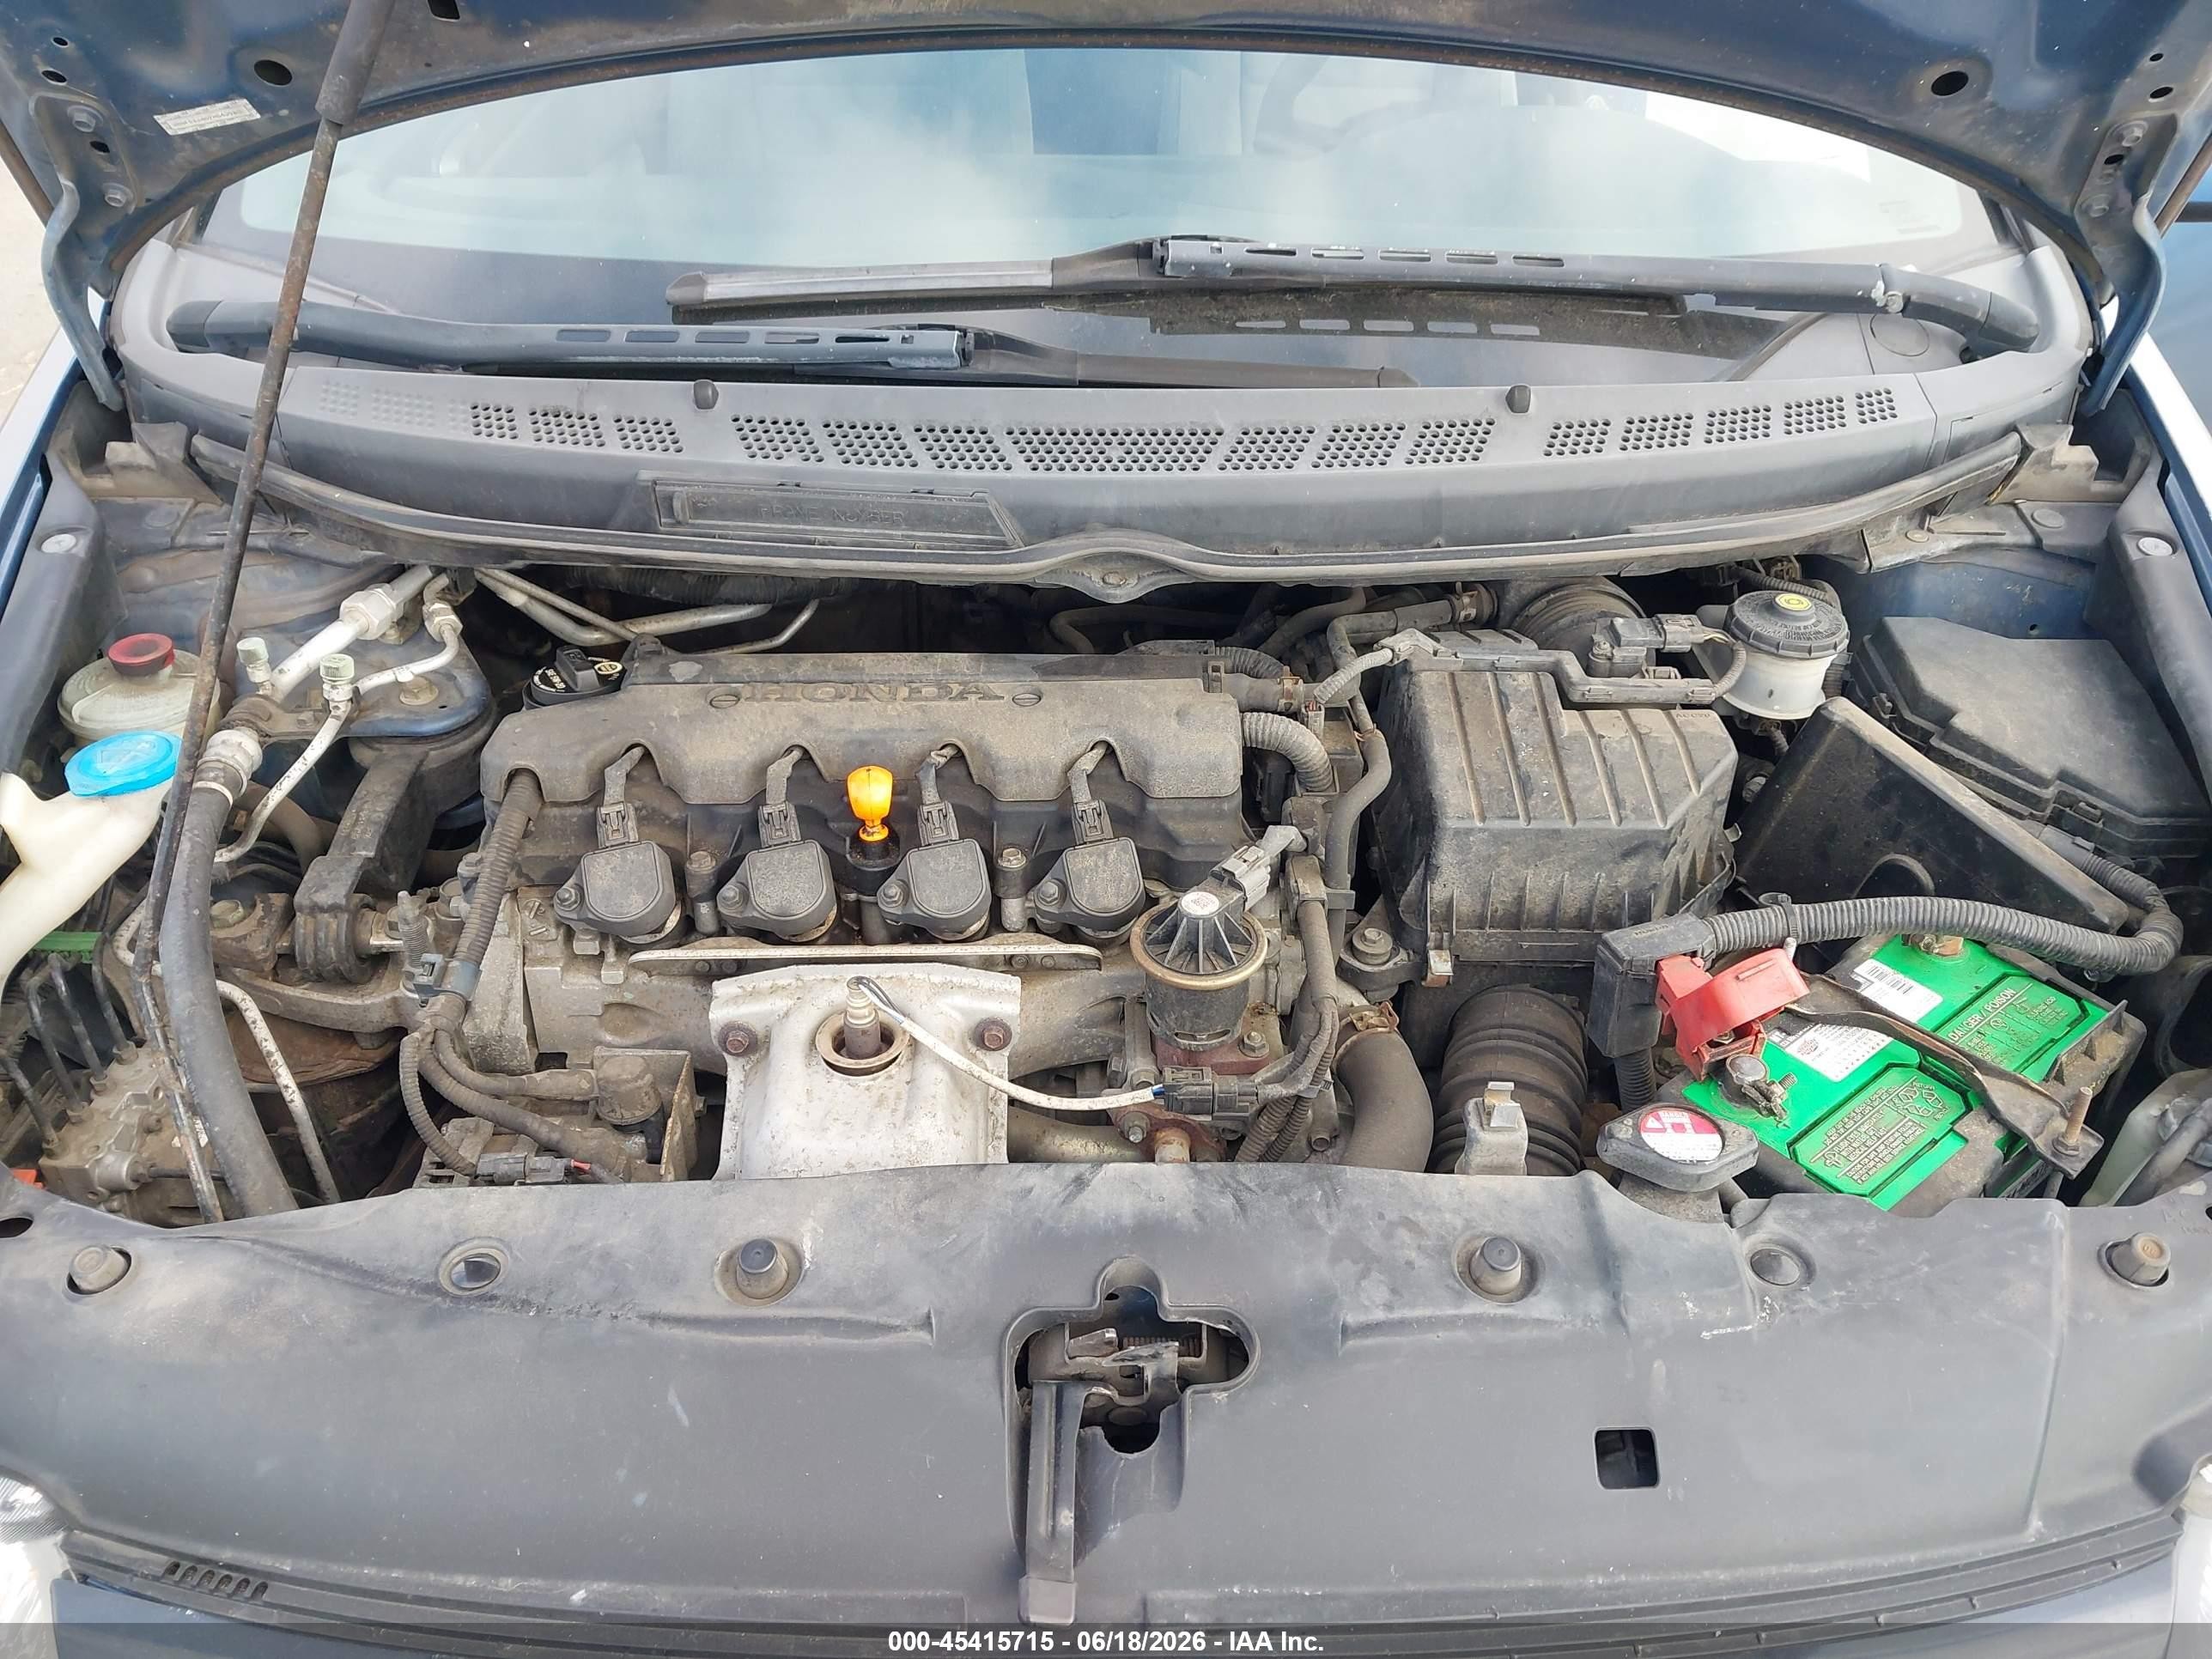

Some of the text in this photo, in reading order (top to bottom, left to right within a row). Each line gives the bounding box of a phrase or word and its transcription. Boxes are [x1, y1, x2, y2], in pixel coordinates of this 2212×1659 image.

[745, 681, 1005, 702] HONDA
[1948, 1012, 1984, 1042] DANGER
[1985, 987, 2018, 1012] POISON
